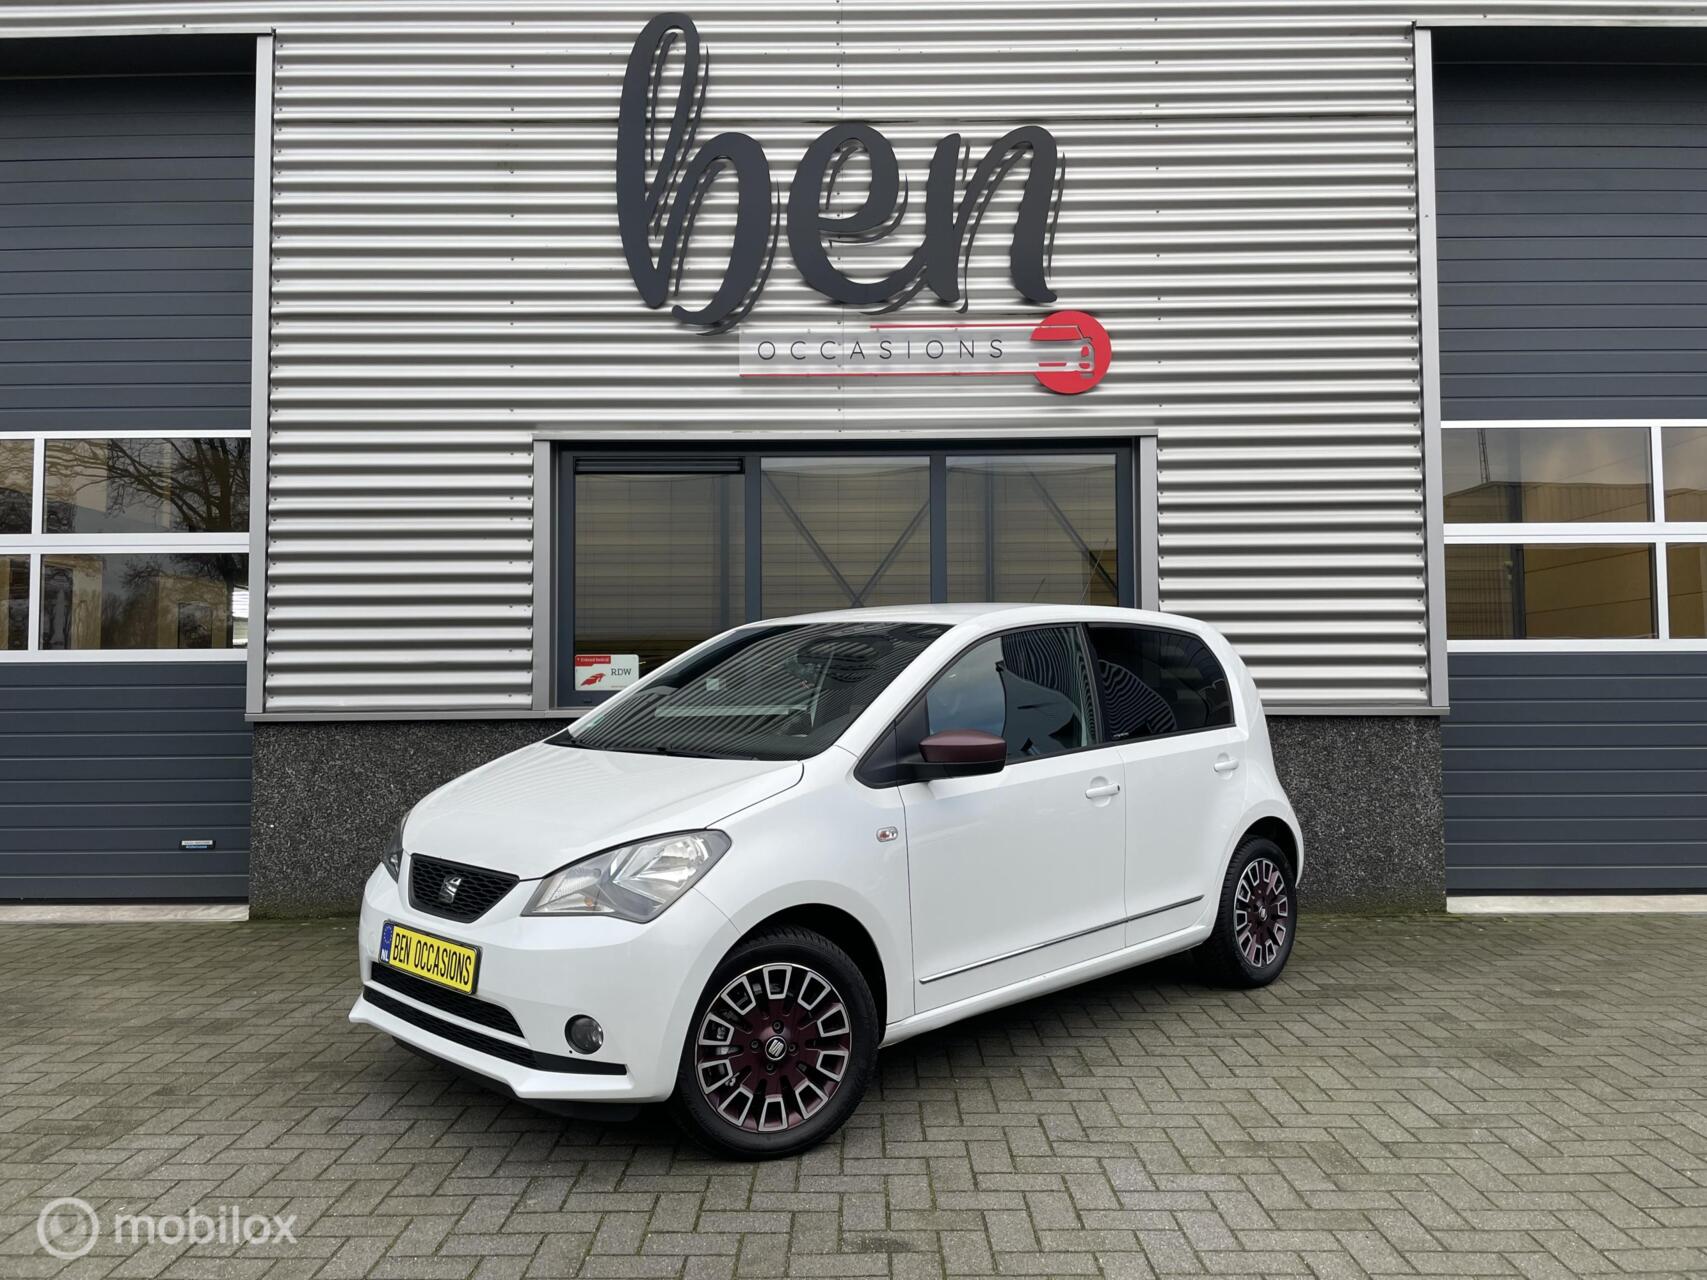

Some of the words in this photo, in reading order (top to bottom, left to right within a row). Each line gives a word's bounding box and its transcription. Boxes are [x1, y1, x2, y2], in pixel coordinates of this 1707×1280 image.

[616, 12, 1062, 328] ben
[757, 339, 1004, 361] OCCASIONS
[610, 668, 632, 676] RDW
[393, 932, 412, 965] BEN
[414, 939, 472, 986] OCCASIONS
